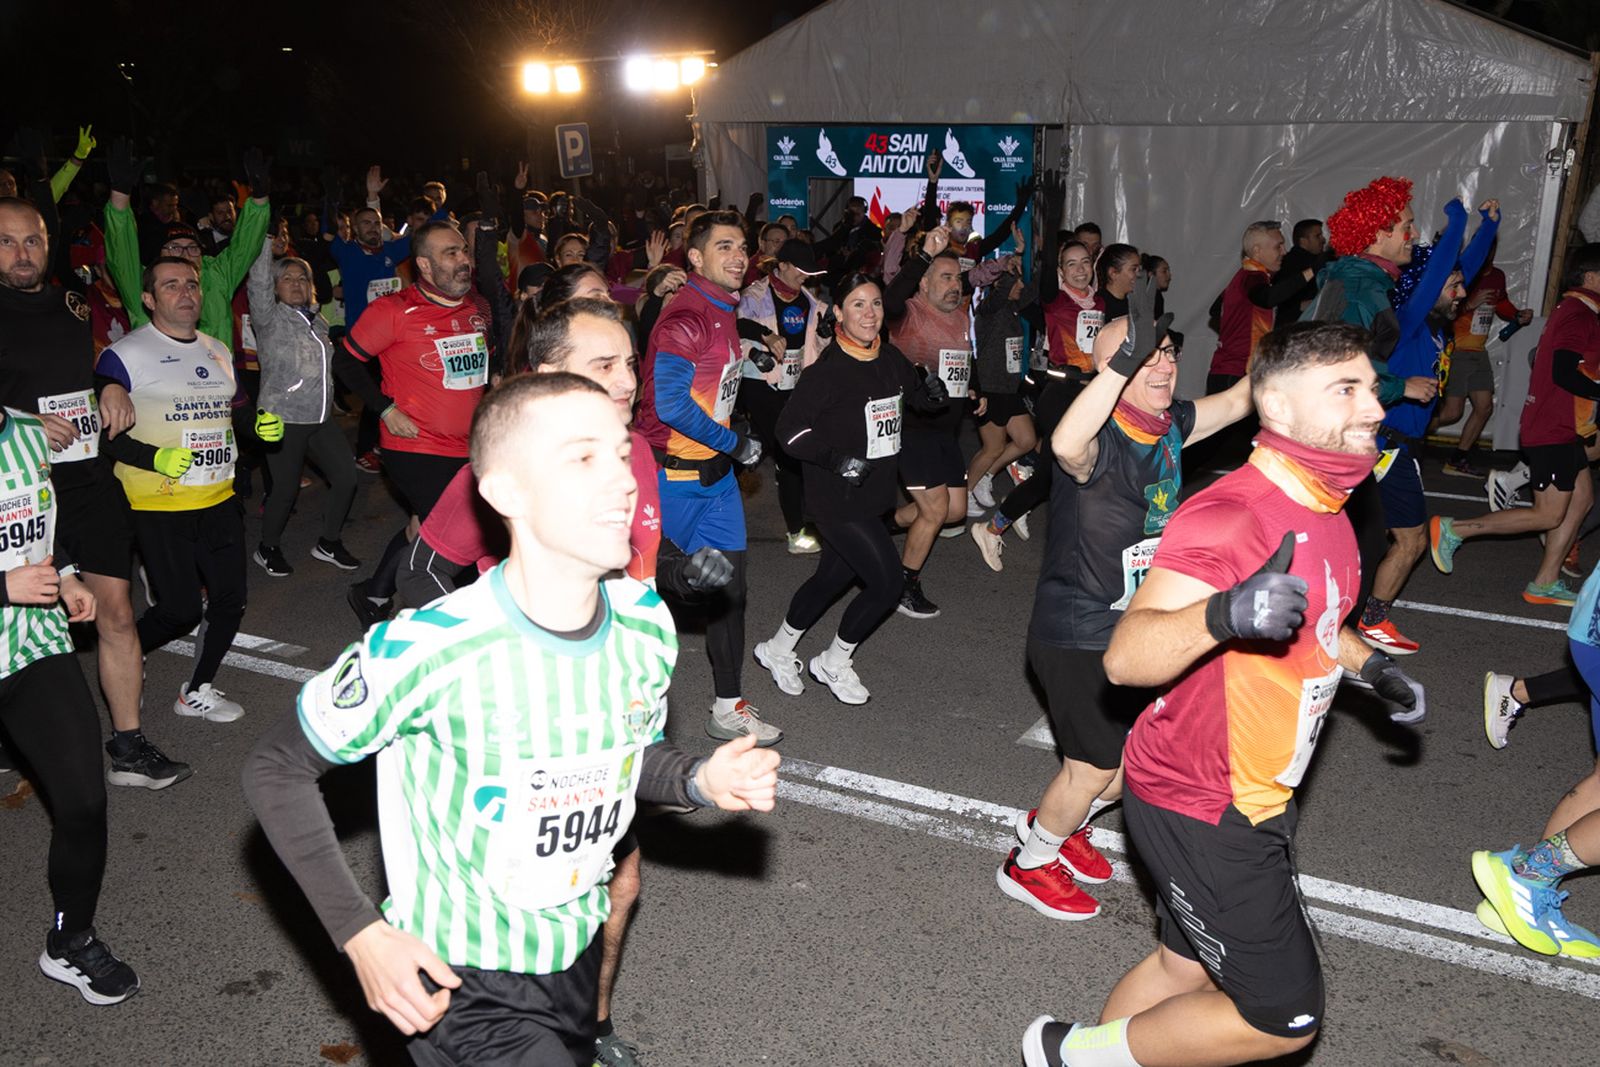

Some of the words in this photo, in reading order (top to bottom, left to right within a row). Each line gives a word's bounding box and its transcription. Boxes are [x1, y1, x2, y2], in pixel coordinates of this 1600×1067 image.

[564, 131, 584, 171] P
[864, 133, 888, 154] 43
[888, 133, 928, 153] SAN
[825, 155, 838, 169] 43
[859, 149, 924, 173] ANTÓN
[951, 155, 965, 170] 43
[783, 316, 805, 324] NASA
[448, 352, 485, 373] 12082
[58, 401, 78, 409] NOCHE
[175, 401, 211, 412] SANTA
[165, 412, 189, 422] LOS
[194, 446, 231, 467] 5906
[22, 496, 32, 507] DE
[6, 507, 33, 522] ANTÓN
[1131, 559, 1147, 568] SAN
[1499, 695, 1510, 717] HOKA
[550, 771, 592, 790] NOCHE
[594, 768, 609, 783] DE
[527, 795, 559, 812] SAN
[536, 798, 622, 858] 5944
